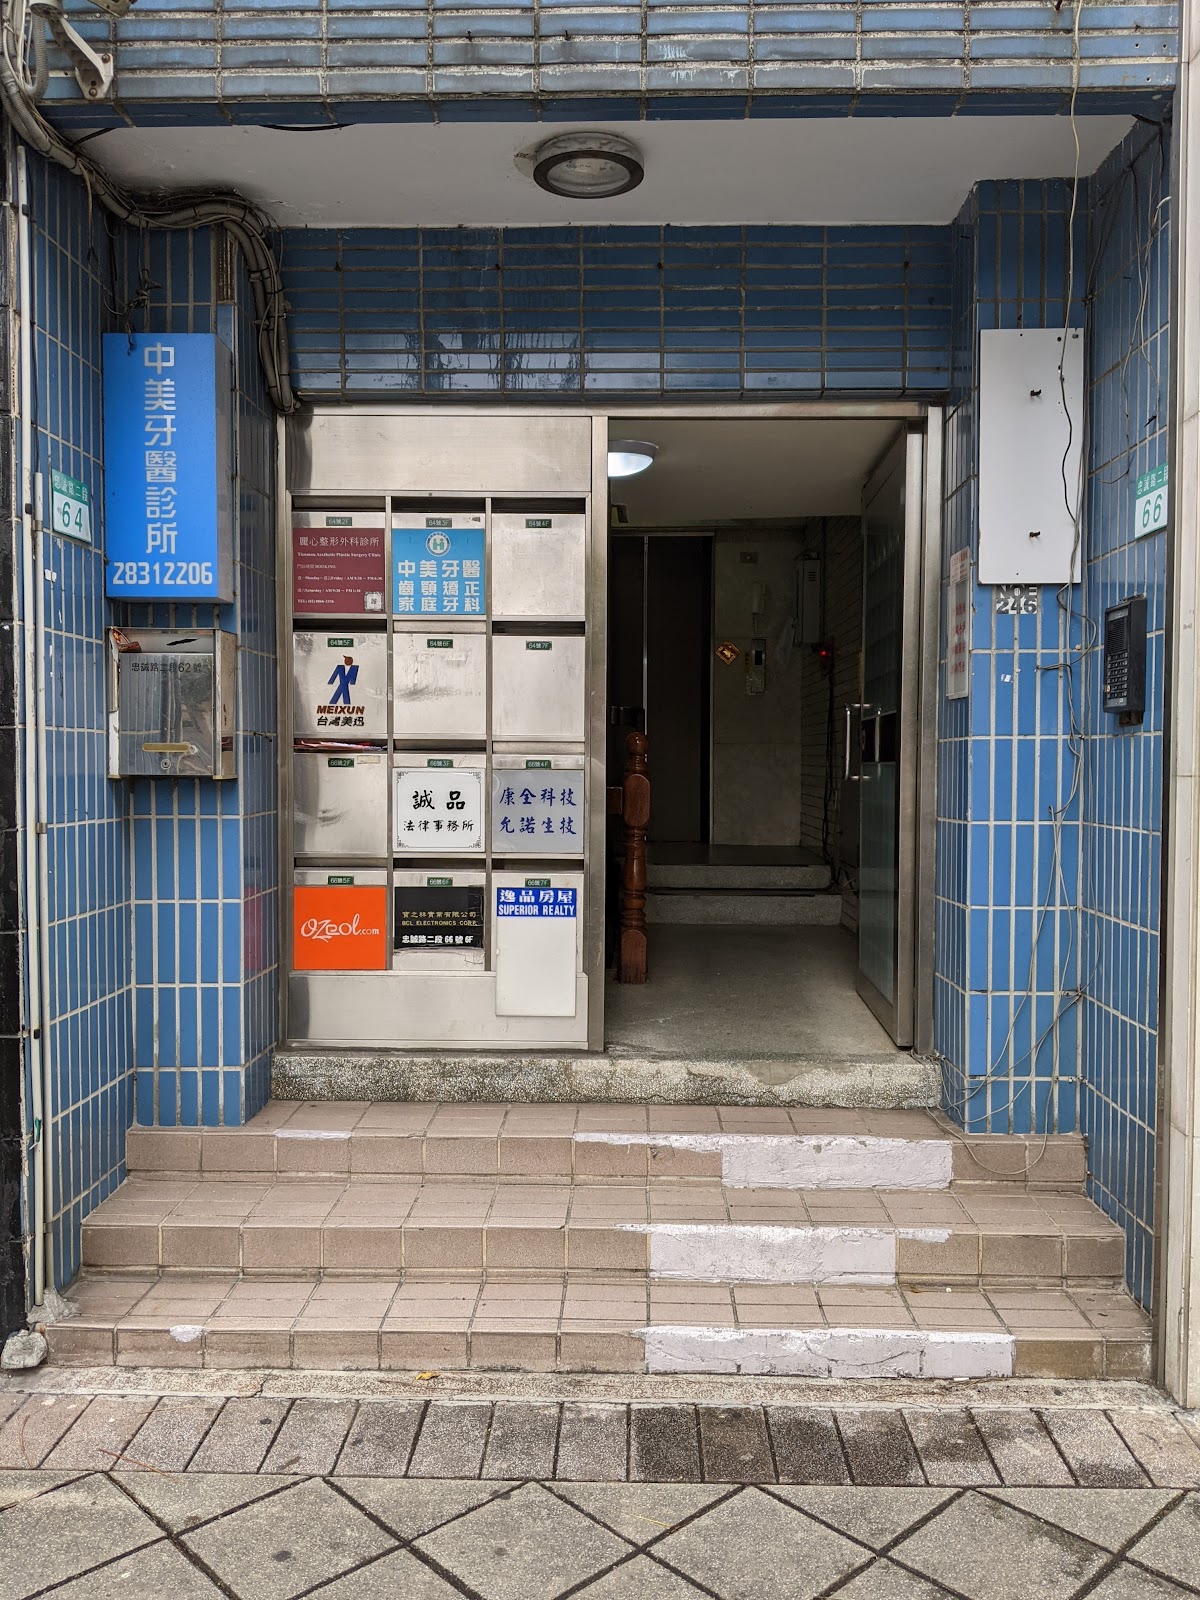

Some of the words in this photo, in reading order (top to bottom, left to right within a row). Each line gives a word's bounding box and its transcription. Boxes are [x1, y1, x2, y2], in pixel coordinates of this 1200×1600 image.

[143, 342, 178, 555] 中美牙醫診所
[62, 501, 83, 533] 64
[1142, 493, 1163, 528] 66
[328, 517, 350, 525] 64號2F
[112, 561, 213, 585] 28312206
[398, 560, 480, 578] 中美牙醫
[398, 580, 480, 596] 齒顎矯正
[398, 597, 480, 612] 家庭牙科
[996, 598, 1037, 614] 246
[316, 705, 365, 715] MEIXUN
[412, 789, 466, 811] 誠品
[499, 787, 577, 807] 康全科技
[403, 820, 475, 833] 法律事務所
[499, 816, 577, 835] 允諾生技
[500, 889, 573, 904] 逸品房屋
[498, 904, 539, 916] SUPERIOR
[542, 904, 575, 916] REALTY
